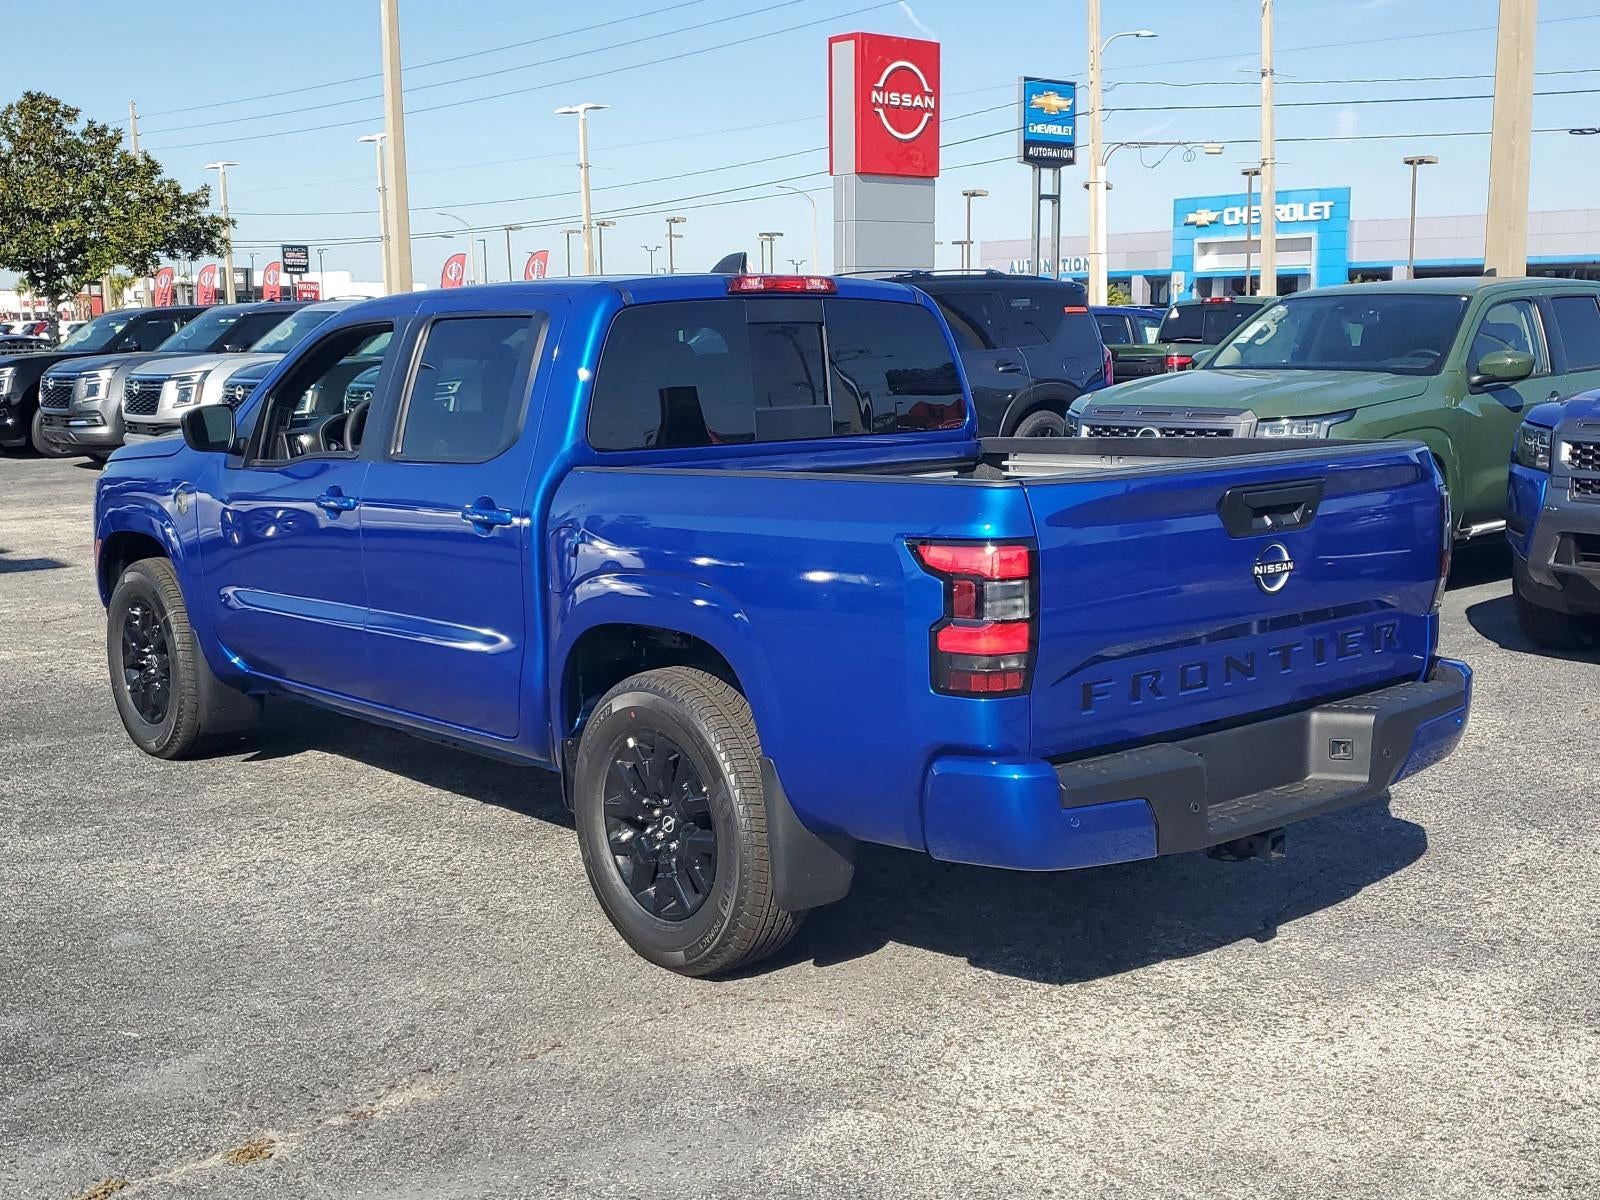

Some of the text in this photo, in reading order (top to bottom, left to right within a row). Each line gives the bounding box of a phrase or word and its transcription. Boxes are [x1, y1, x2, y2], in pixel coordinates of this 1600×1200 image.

[871, 90, 935, 109] NISSAN
[1029, 123, 1073, 136] CHEVROLET
[1029, 146, 1073, 159] AUTONATION
[1223, 201, 1334, 226] CHEROLET
[1009, 257, 1089, 273] AUTNTION
[1254, 561, 1294, 575] NISSAN
[1080, 621, 1399, 715] FRONTIER
[699, 918, 722, 950] PRIMACY
